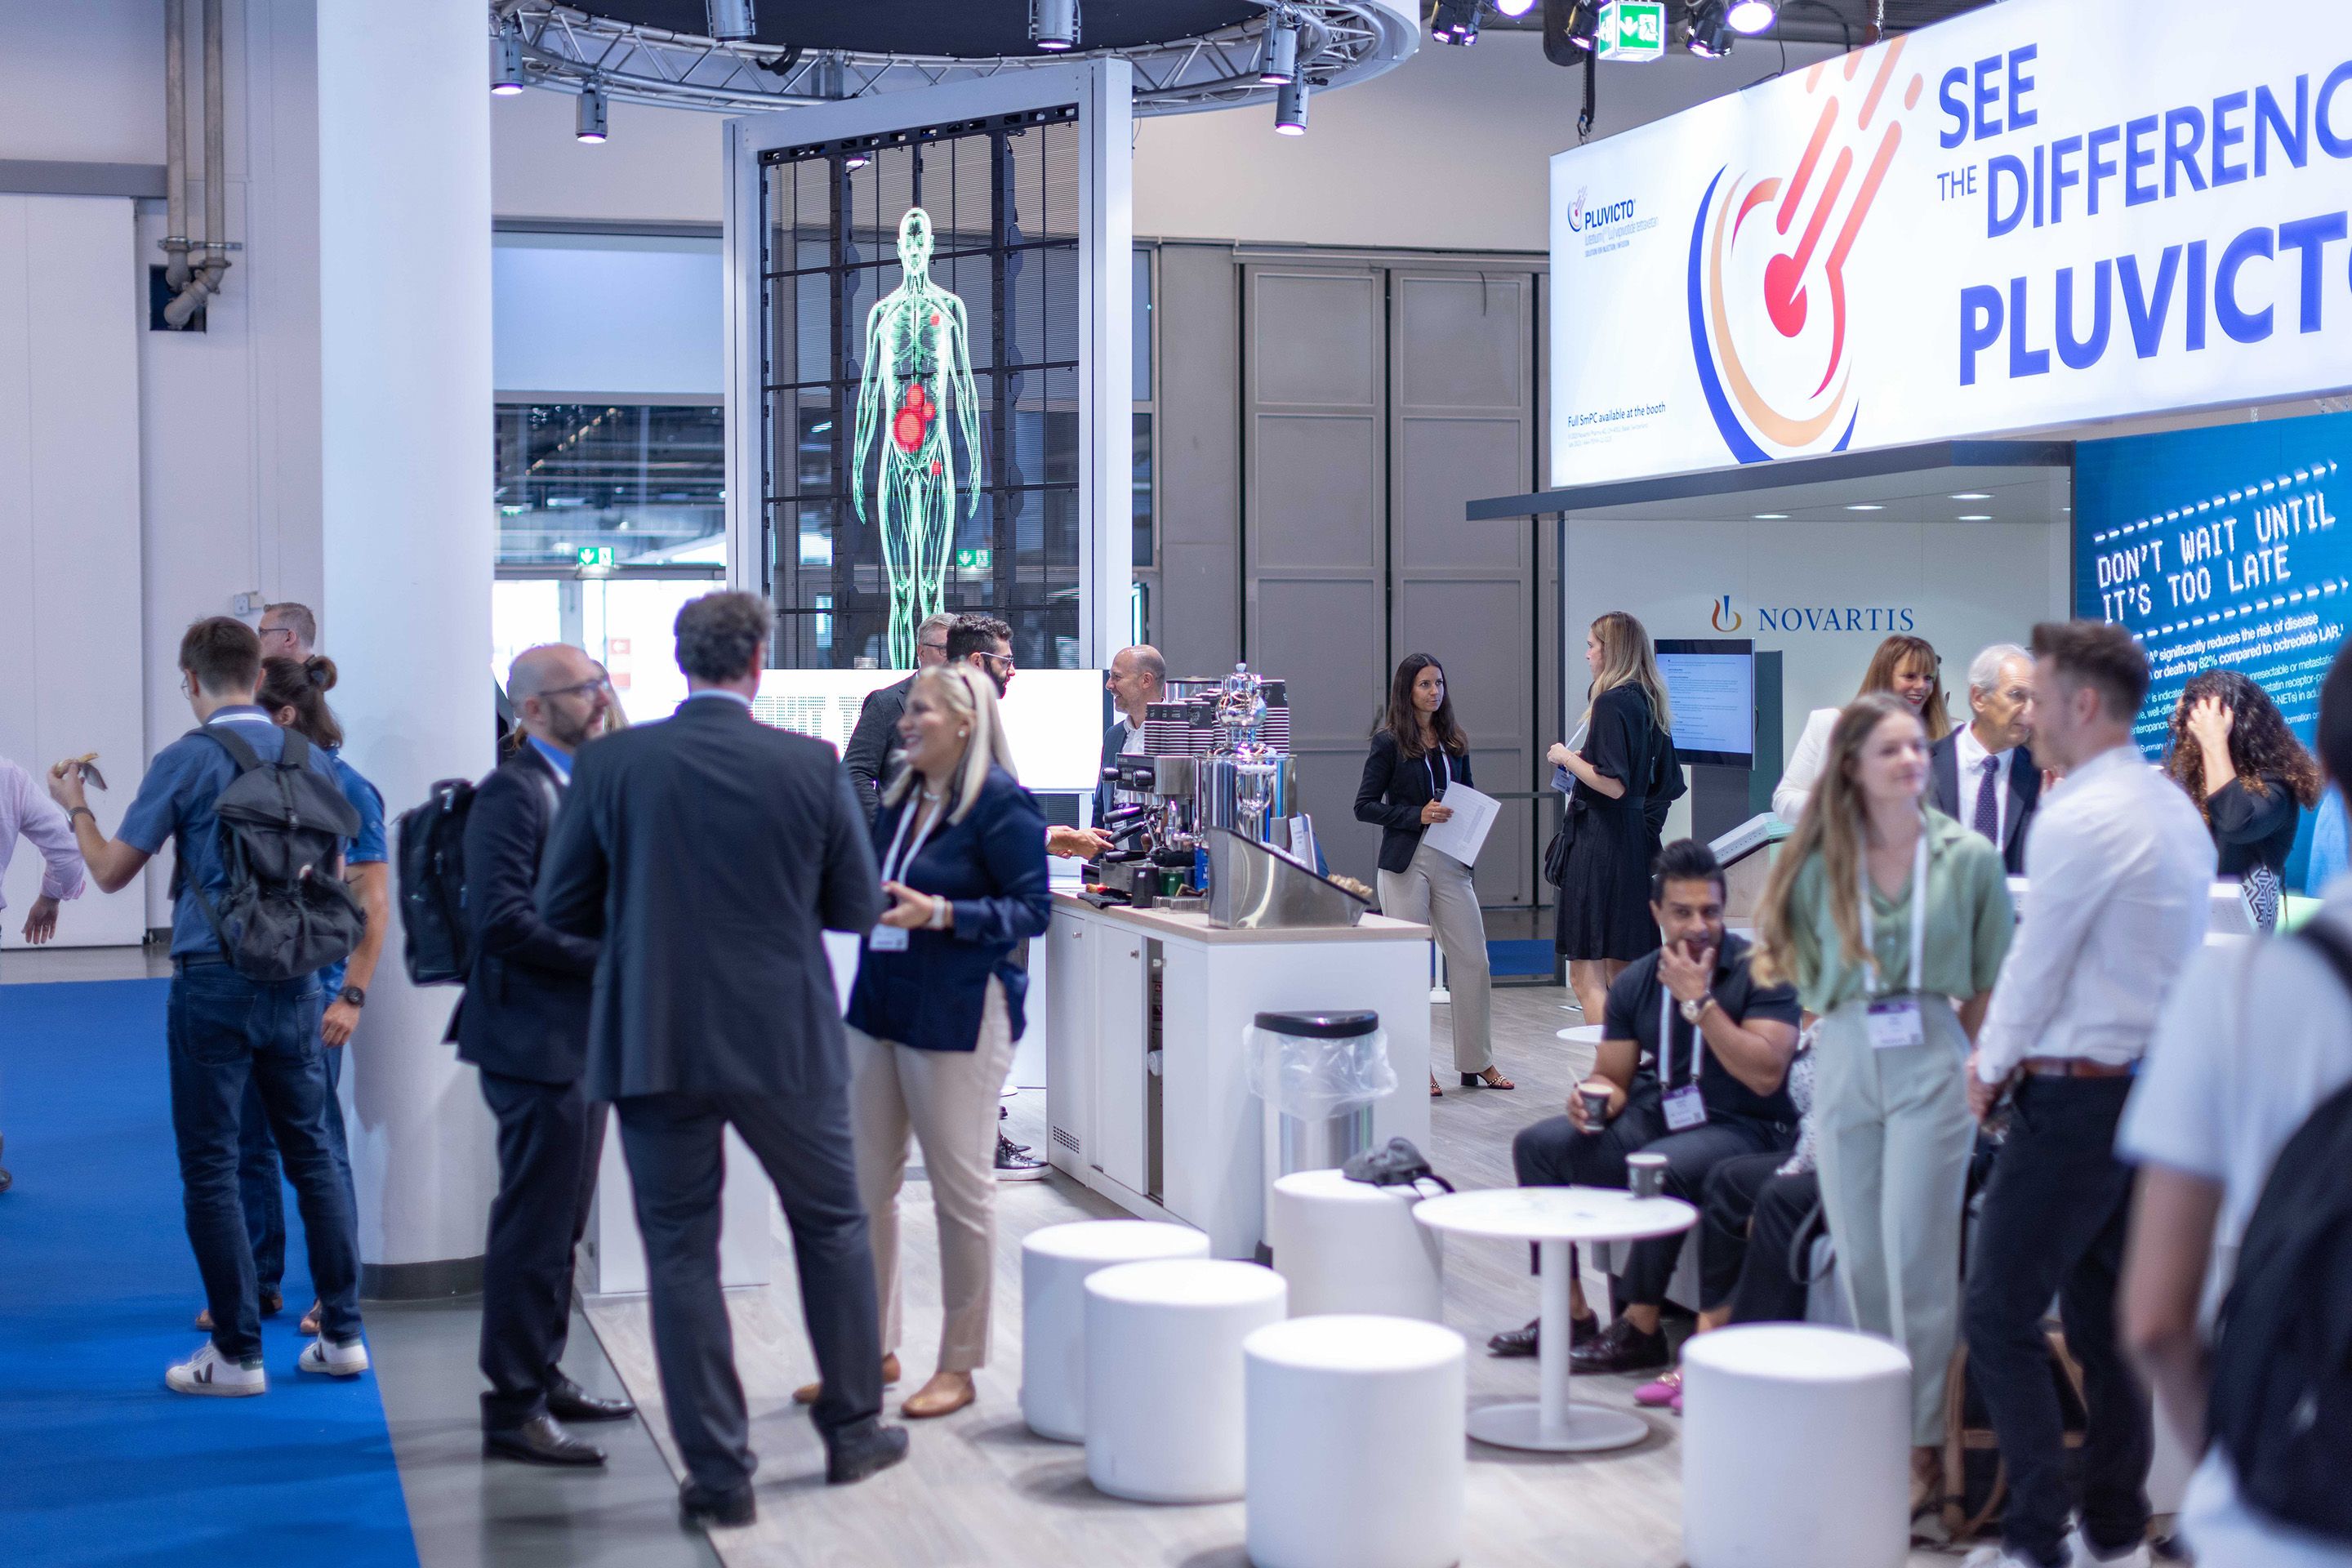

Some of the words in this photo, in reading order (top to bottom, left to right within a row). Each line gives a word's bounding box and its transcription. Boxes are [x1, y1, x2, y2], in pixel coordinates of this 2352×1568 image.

[1939, 42, 2038, 149] SEE
[1937, 164, 1977, 202] THE
[1987, 59, 2352, 238] DIFFERENC
[1960, 210, 2352, 386] PLUVICT
[1568, 415, 1579, 427] Full
[1598, 408, 1625, 422] available
[1627, 408, 1633, 418] at
[1634, 405, 1645, 416] the
[1646, 401, 1666, 415] booth
[2097, 540, 2163, 588] DON'T
[2180, 519, 2237, 565] WAIT
[2255, 491, 2336, 542] UNTIL
[2102, 583, 2152, 624] IT'S
[2167, 567, 2212, 607] TOO
[2227, 545, 2291, 592] LATE
[1758, 608, 1914, 631] NOVARTIS
[2159, 639, 2206, 662] significantly
[2207, 633, 2241, 650] reduces
[2241, 629, 2256, 641] the
[2256, 623, 2274, 637] risk
[2274, 619, 2284, 634] of
[2284, 612, 2319, 630] disease
[2154, 669, 2163, 679] or
[2163, 662, 2187, 678] death
[2187, 659, 2198, 674] by
[2198, 654, 2218, 669] 82%
[2219, 644, 2261, 665] compared
[2262, 642, 2272, 653] to
[2273, 631, 2319, 652] octreotide
[2290, 662, 2298, 672] or
[2151, 693, 2158, 702] is
[2299, 691, 2305, 701] in
